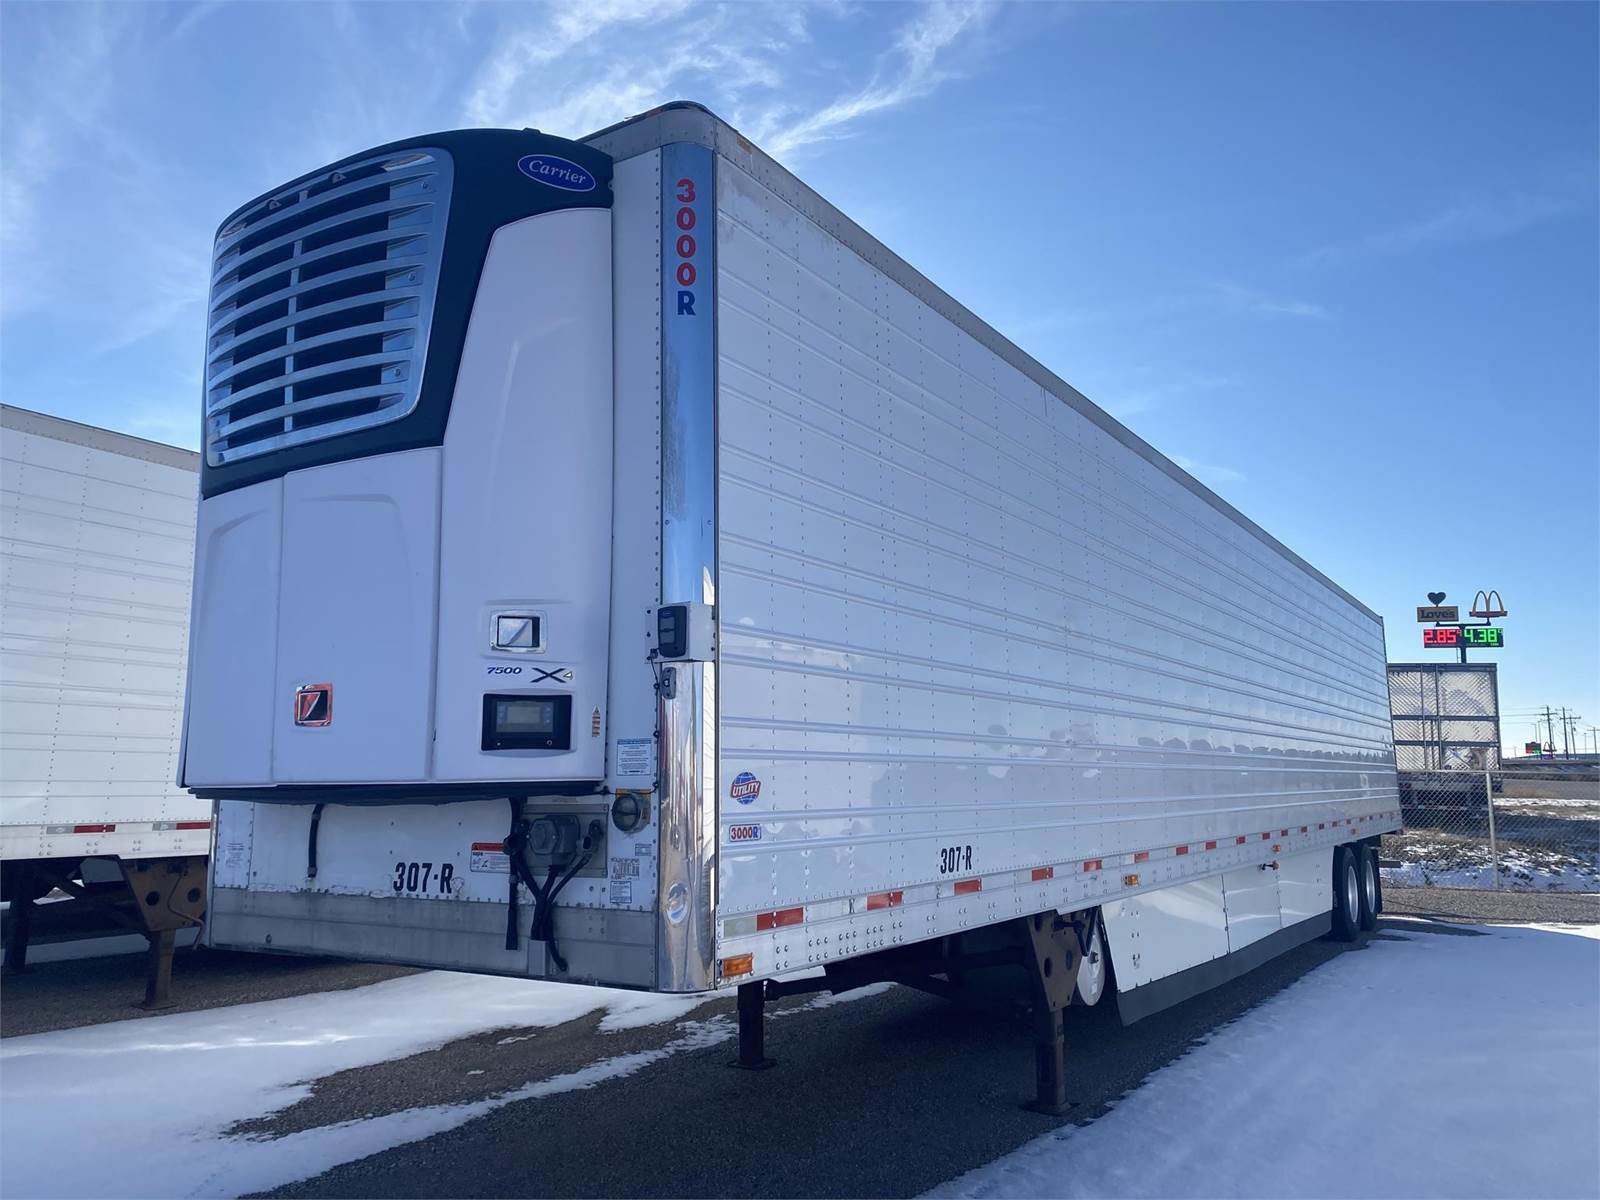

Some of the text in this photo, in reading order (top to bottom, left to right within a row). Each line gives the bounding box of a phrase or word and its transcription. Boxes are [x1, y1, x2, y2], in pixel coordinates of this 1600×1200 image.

[528, 160, 587, 184] Carrier
[676, 178, 697, 316] 3000R
[1424, 629, 1457, 643] 2.85
[1464, 629, 1498, 643] 4.38
[487, 666, 522, 675] 7500
[732, 782, 760, 797] UTILITY
[730, 826, 759, 840] 3000R
